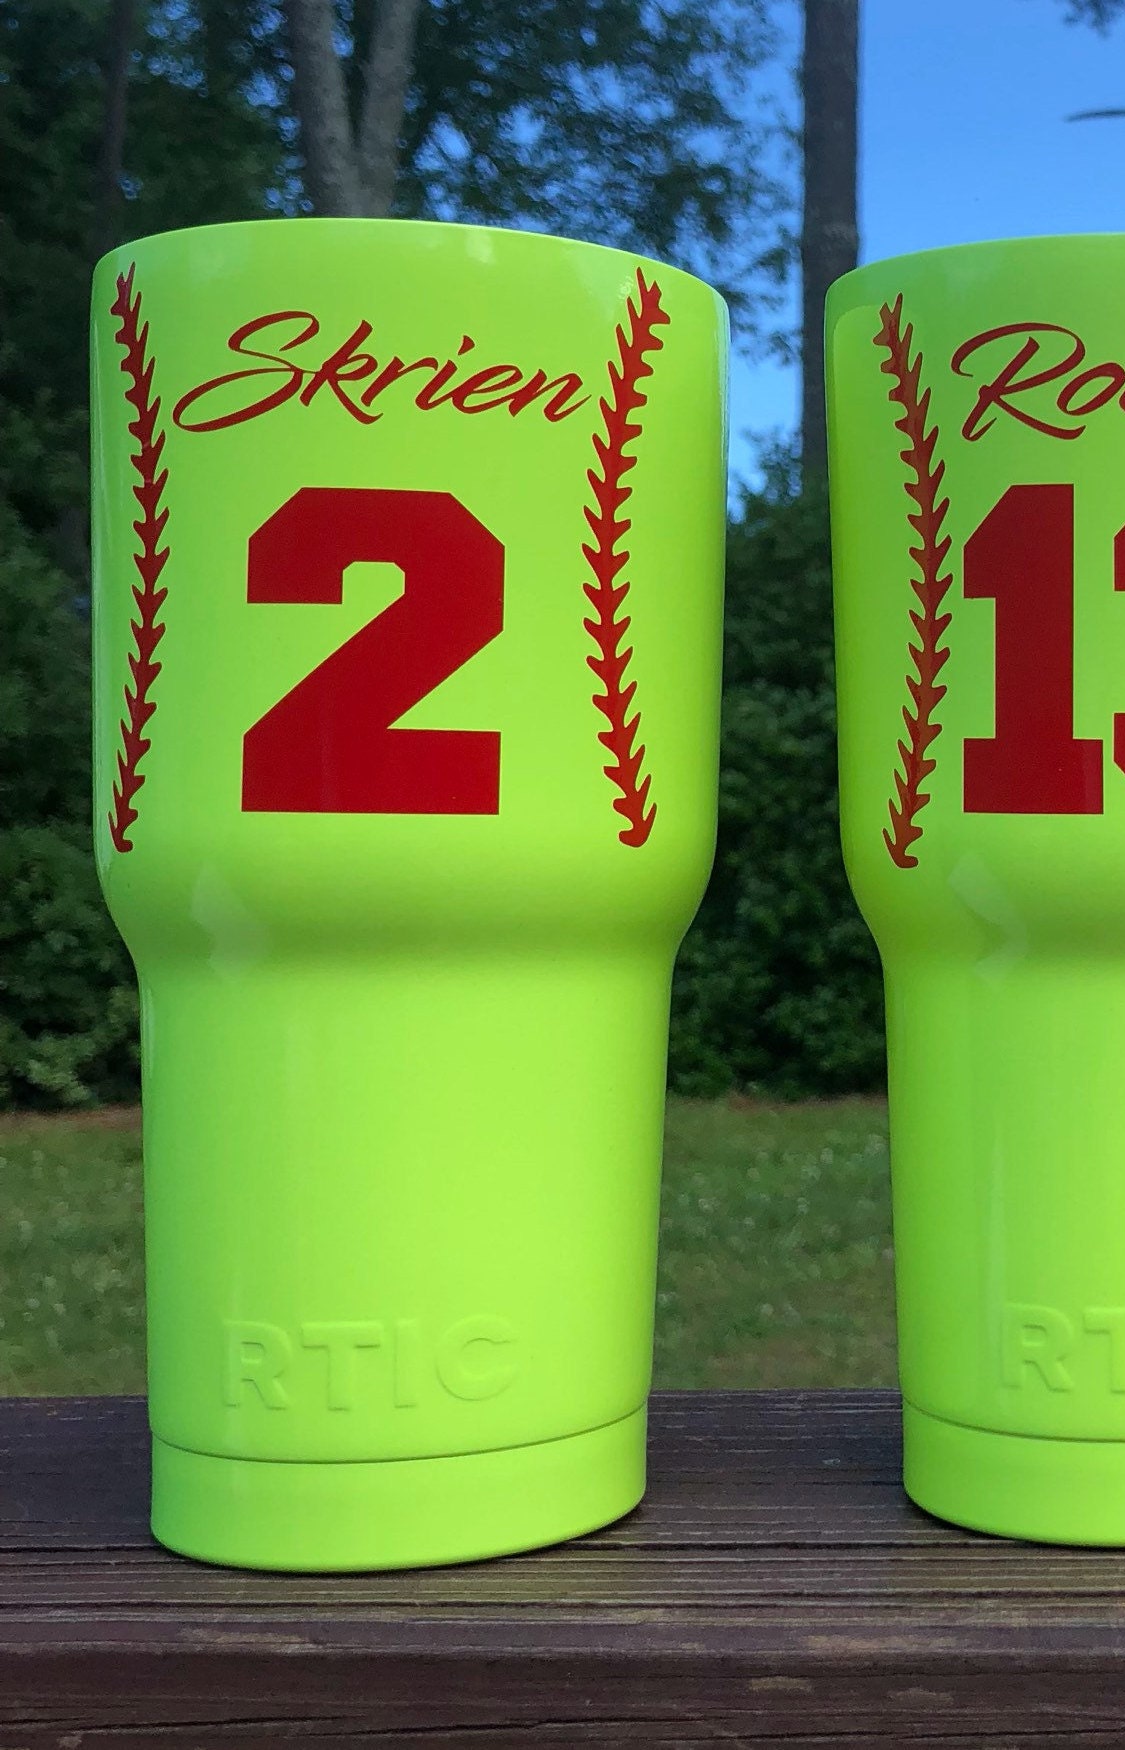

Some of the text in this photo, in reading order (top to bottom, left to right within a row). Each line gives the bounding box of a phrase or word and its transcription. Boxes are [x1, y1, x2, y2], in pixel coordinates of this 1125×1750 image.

[173, 310, 590, 433] Skrien
[242, 486, 505, 816] 2
[222, 1314, 519, 1411] RTIC
